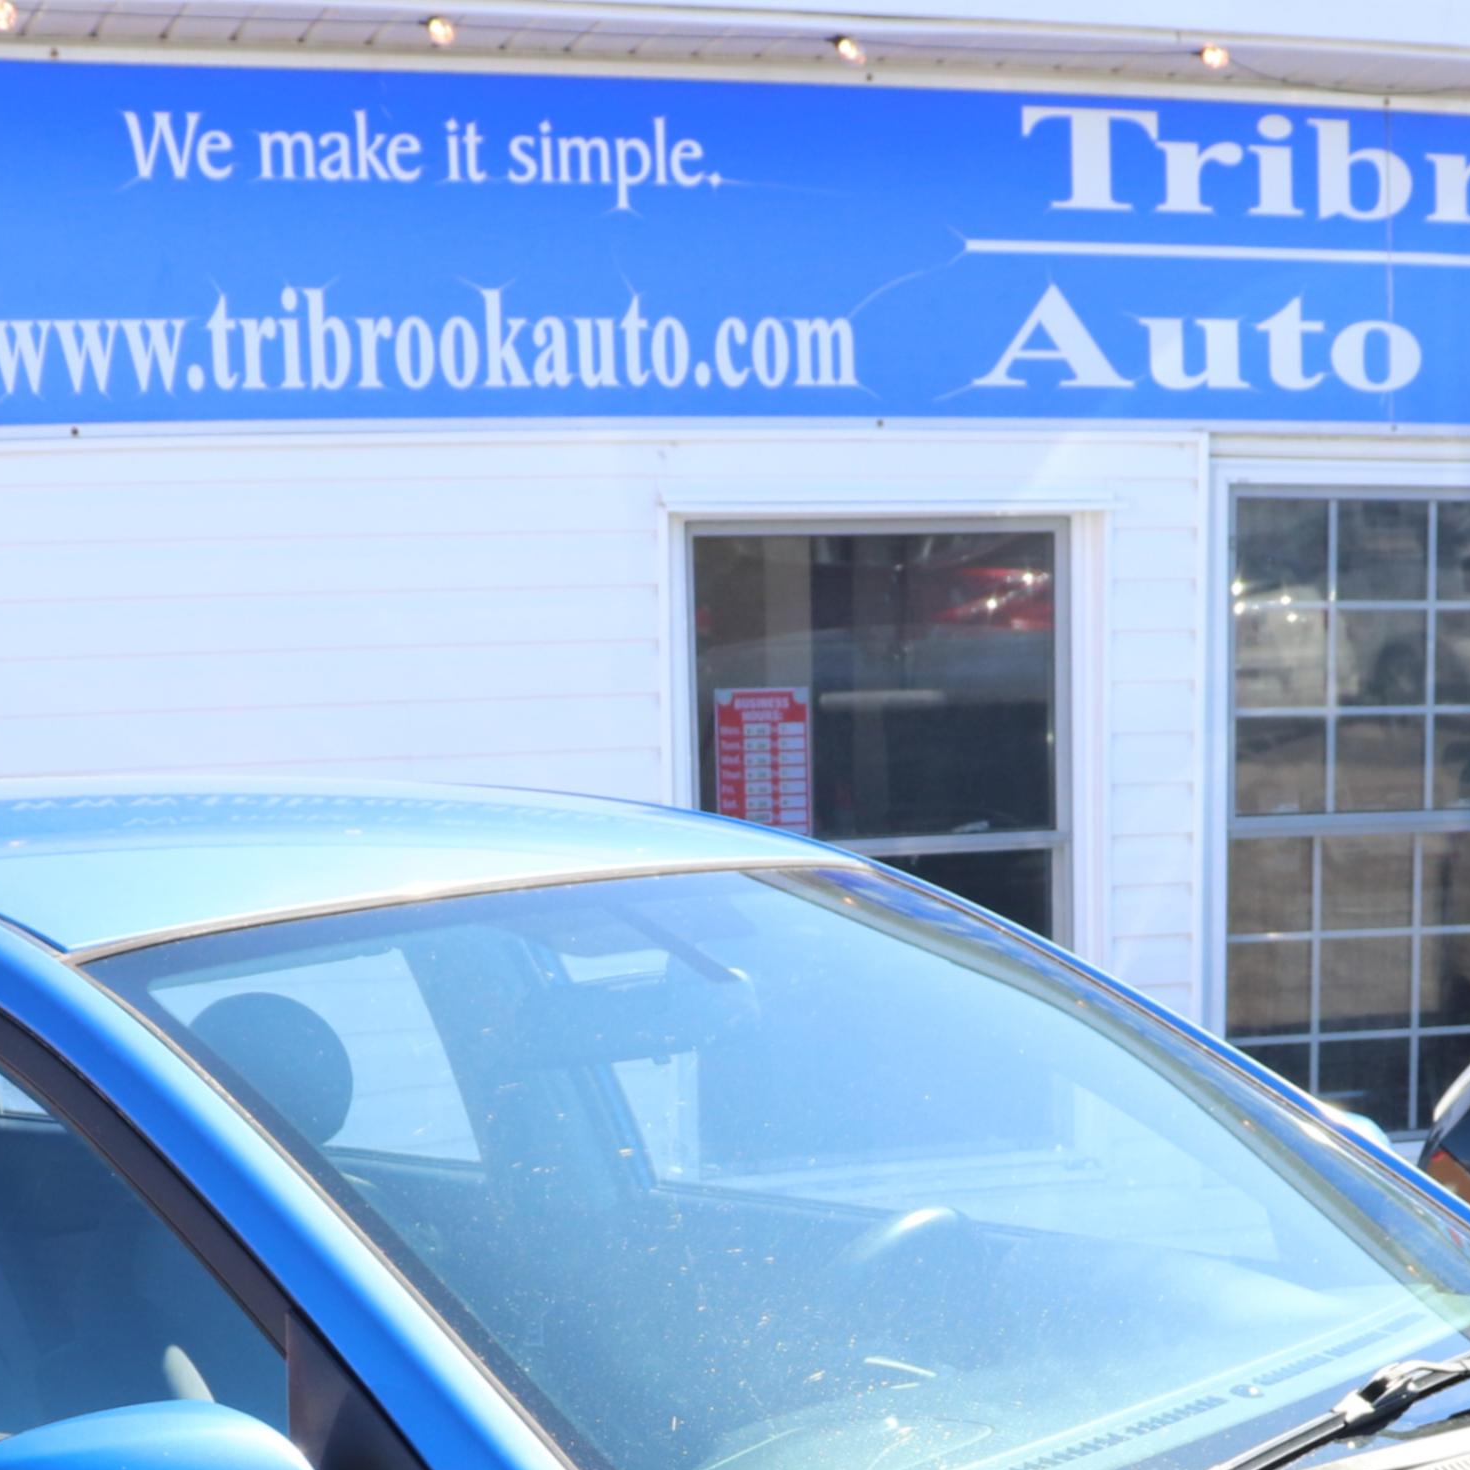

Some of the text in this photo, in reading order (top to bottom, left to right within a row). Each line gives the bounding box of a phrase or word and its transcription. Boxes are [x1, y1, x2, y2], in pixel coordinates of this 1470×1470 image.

[124, 110, 723, 210] We make it simple.
[972, 283, 1423, 393] Auto
